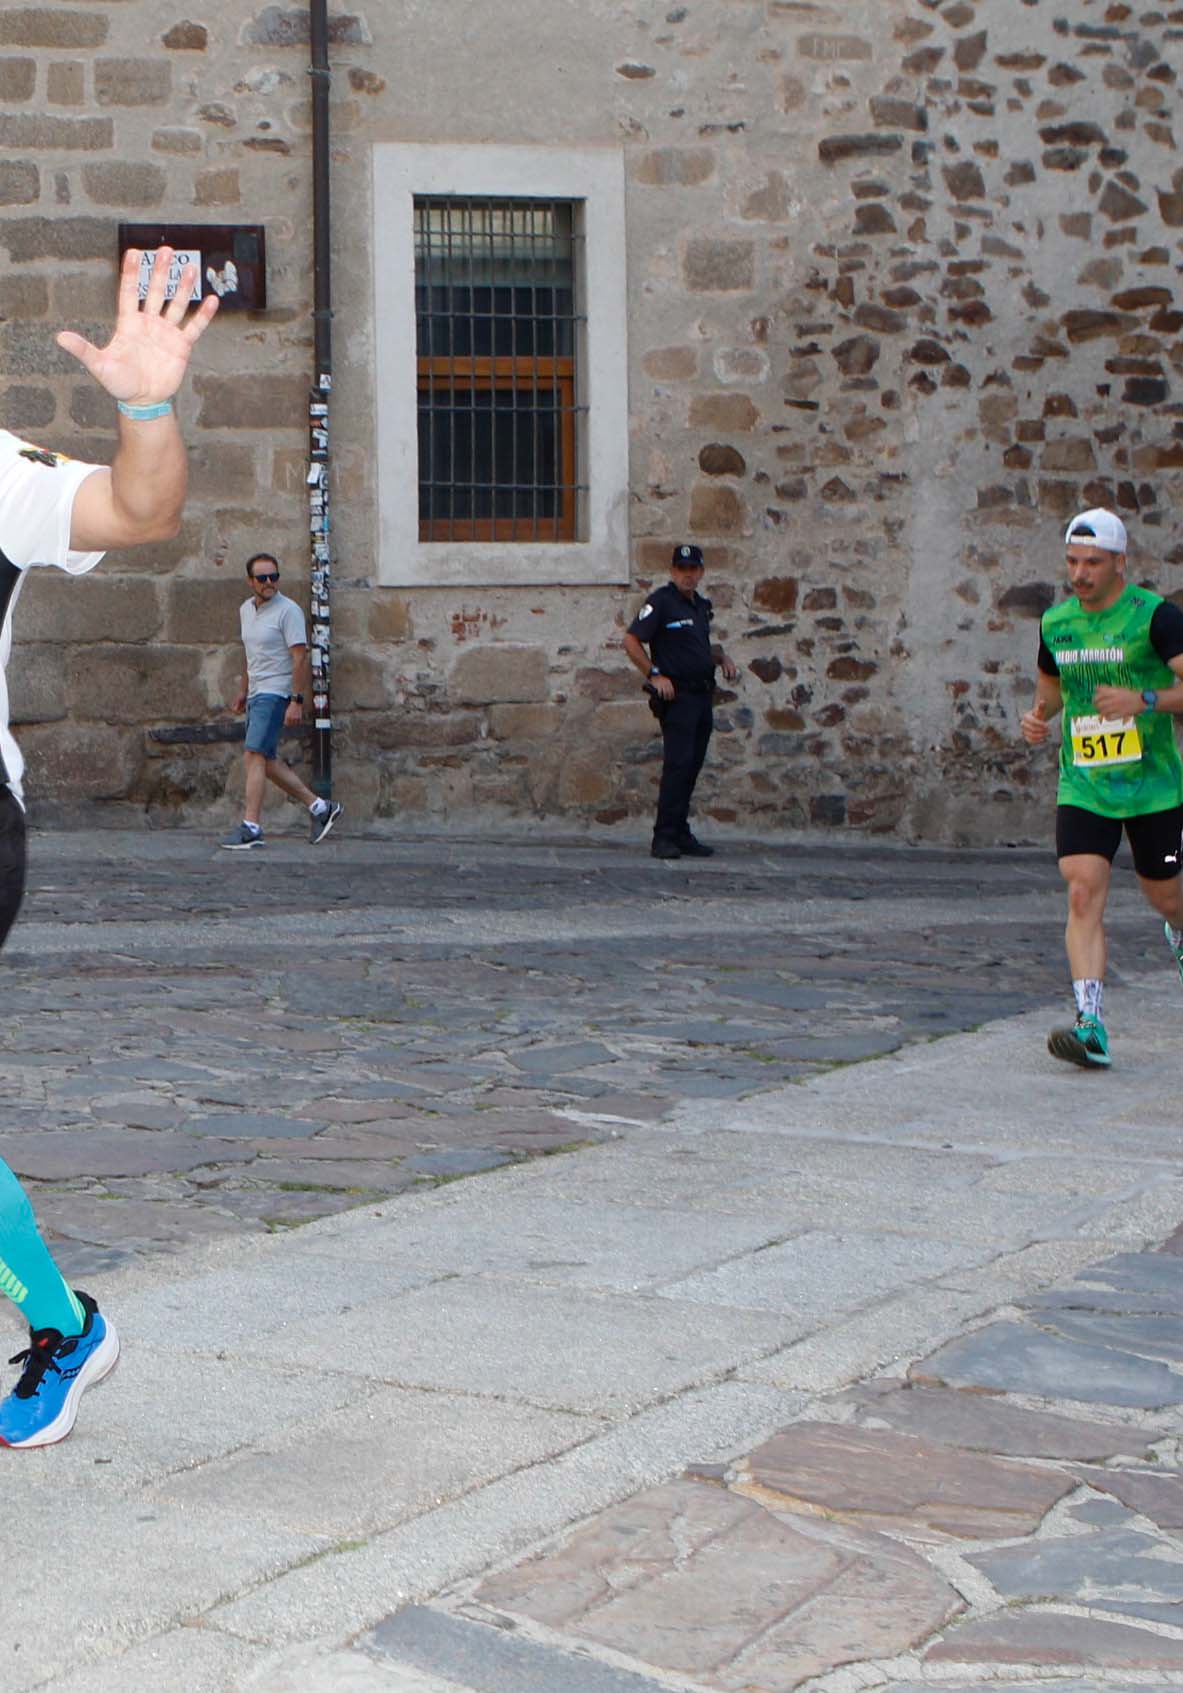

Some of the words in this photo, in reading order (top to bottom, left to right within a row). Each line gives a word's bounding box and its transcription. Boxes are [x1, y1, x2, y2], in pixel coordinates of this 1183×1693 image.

[1056, 649, 1078, 665] MEDIO
[1080, 646, 1124, 663] MARATÓN
[1082, 732, 1126, 759] 517
